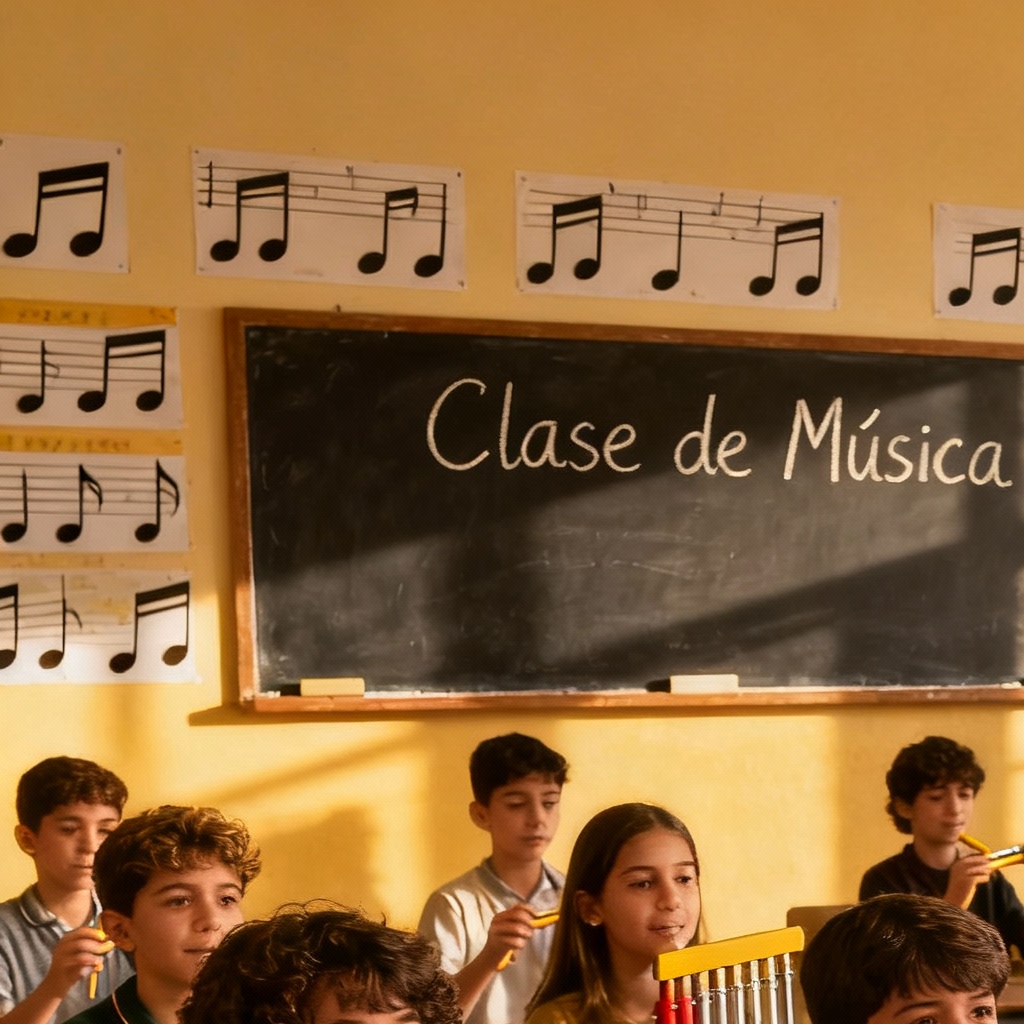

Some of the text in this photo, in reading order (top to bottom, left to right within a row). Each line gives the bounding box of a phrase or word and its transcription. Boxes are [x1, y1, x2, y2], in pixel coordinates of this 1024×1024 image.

[427, 378, 1014, 488] Clase de Música
